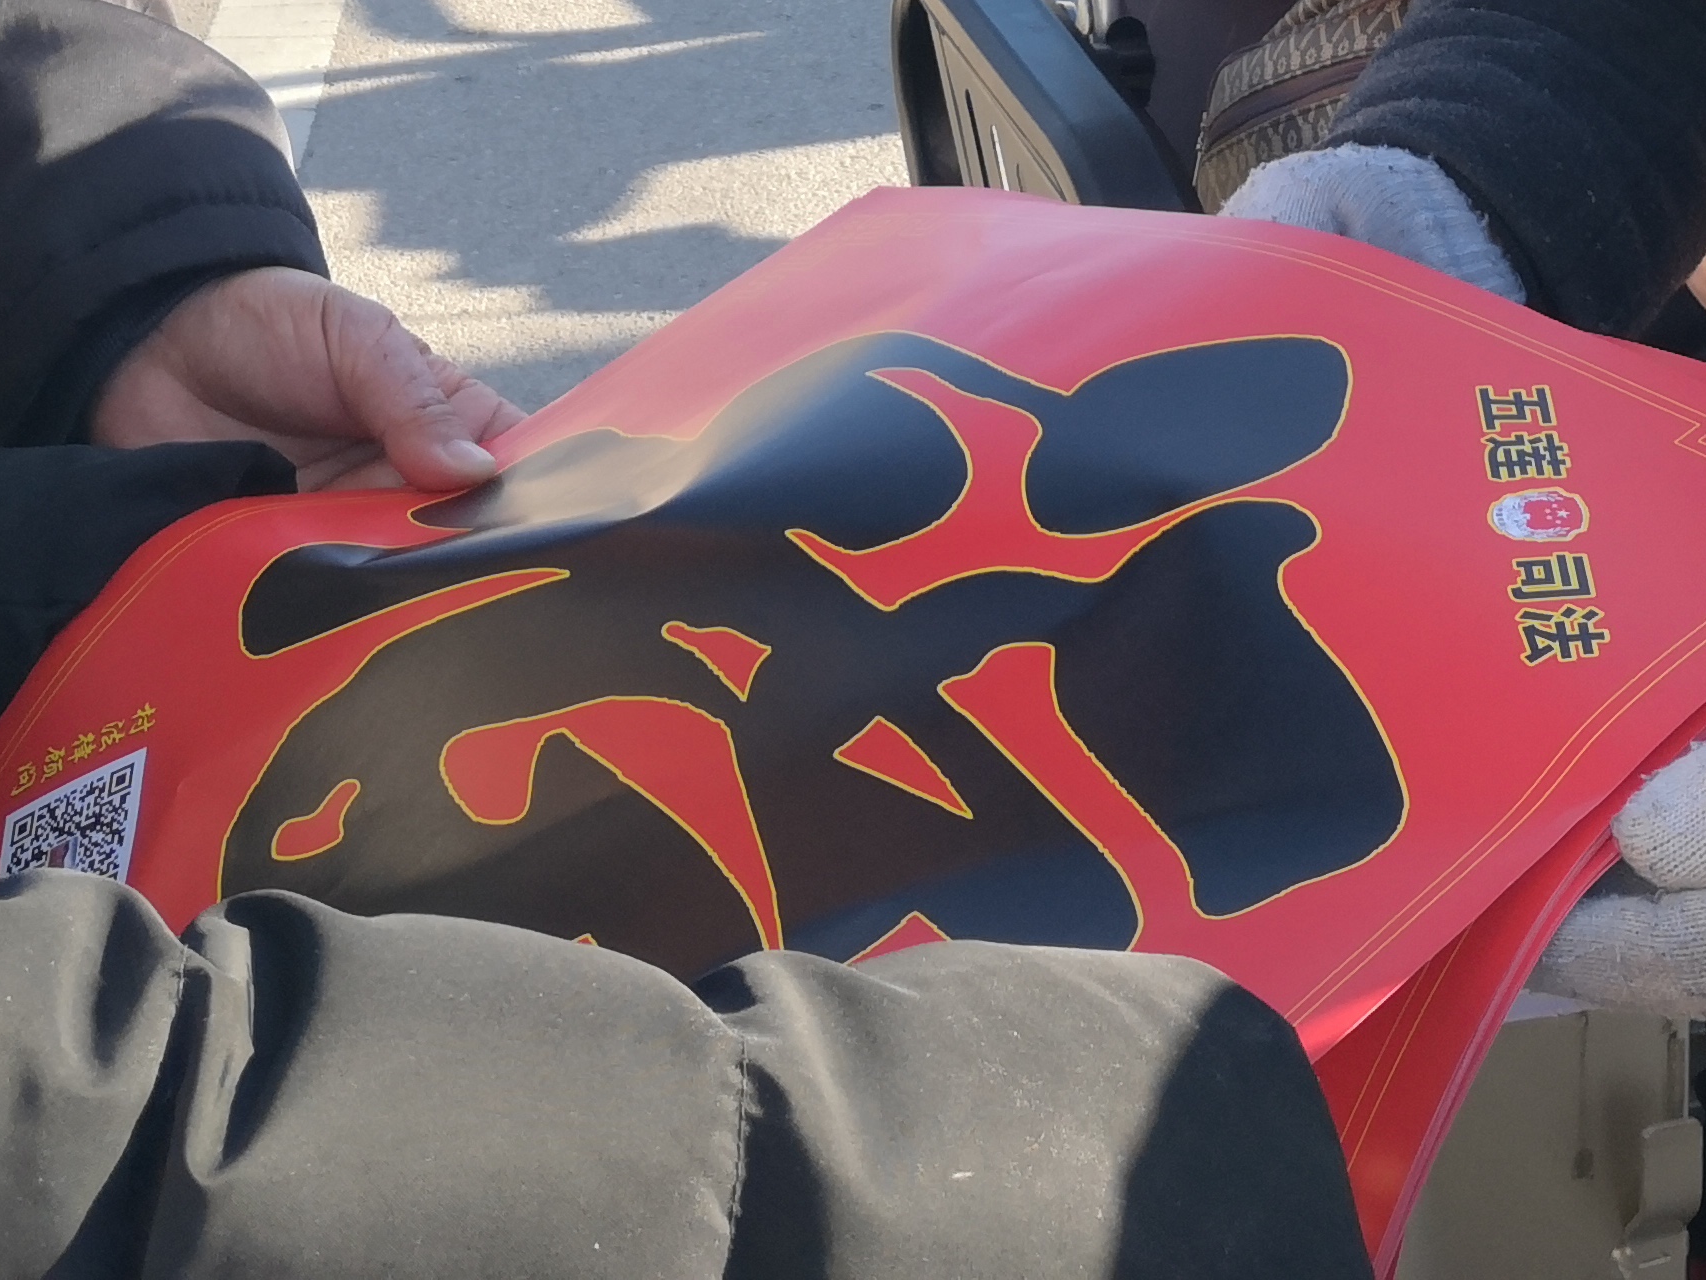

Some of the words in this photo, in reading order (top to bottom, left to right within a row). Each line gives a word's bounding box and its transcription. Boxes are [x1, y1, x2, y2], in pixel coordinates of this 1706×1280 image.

[1475, 385, 1572, 481] 五莲
[219, 329, 1409, 960] 福
[1508, 552, 1610, 666] 司法
[10, 702, 156, 797] 村法律顾问
